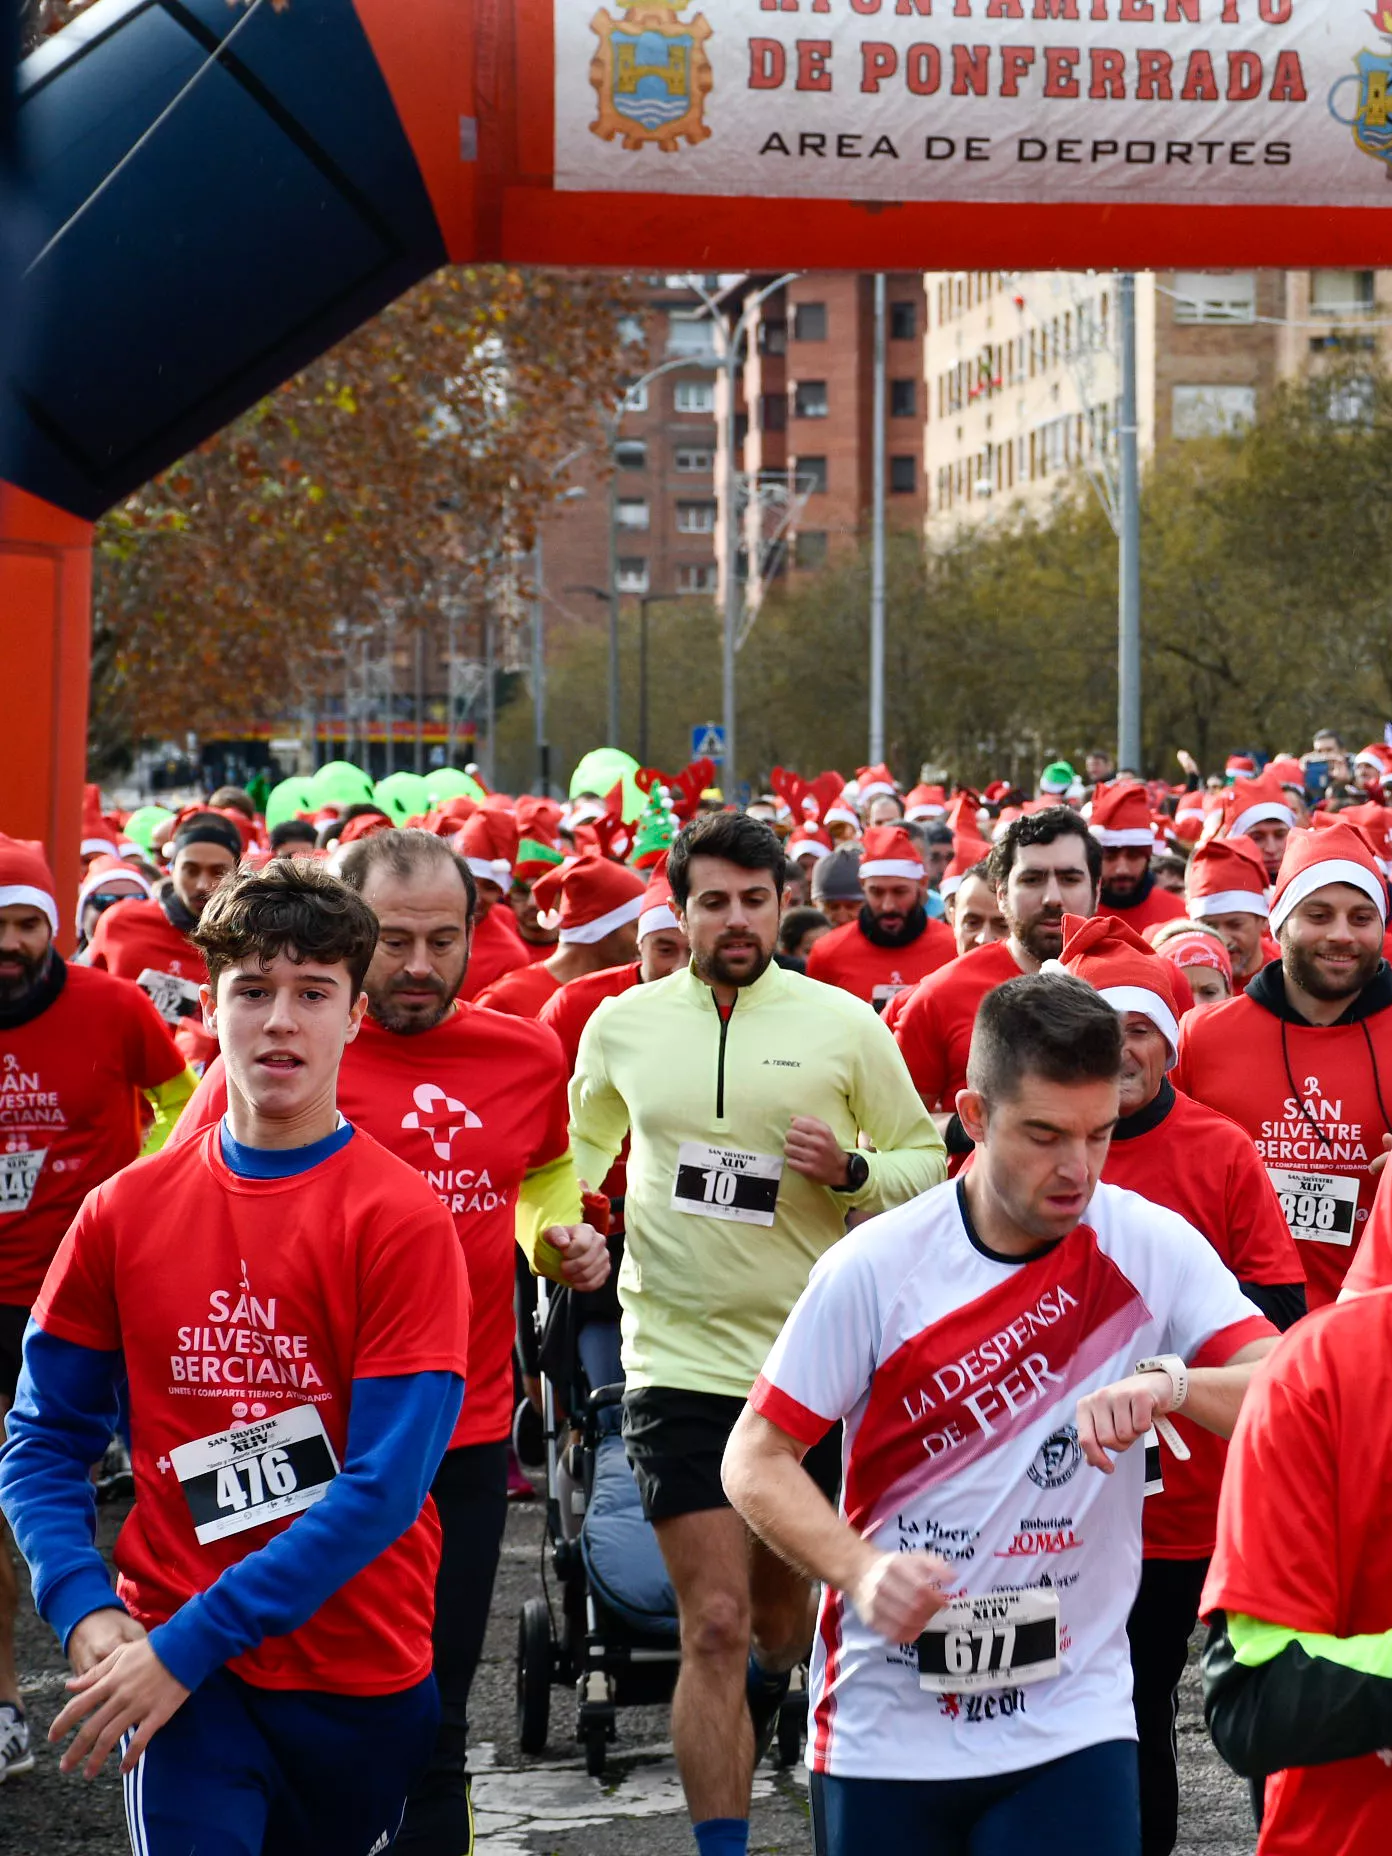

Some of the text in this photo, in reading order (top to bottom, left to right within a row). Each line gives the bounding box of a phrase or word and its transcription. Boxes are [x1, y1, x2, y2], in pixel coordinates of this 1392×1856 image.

[747, 38, 1308, 102] DE PONFERRADA
[758, 131, 1292, 166] AREA DE DEPORTES
[772, 1059, 801, 1068] TERREX
[0, 1072, 40, 1092] AN
[0, 1108, 66, 1124] CIANA
[1283, 1098, 1342, 1121] SAN
[1261, 1121, 1362, 1140] SILVESTRE
[720, 1157, 748, 1169] XLIV
[702, 1170, 737, 1206] 10
[1300, 1182, 1326, 1192] XLIV
[207, 1290, 276, 1330] SAN
[177, 1327, 308, 1359] SILVESTRE
[902, 1284, 1080, 1423] LA DESPENSA
[170, 1355, 323, 1389] BERCIANA
[198, 1389, 245, 1398] COMPARTE
[248, 1390, 283, 1399] TIEMPO
[921, 1420, 967, 1459] DE
[960, 1351, 1066, 1441] FER
[207, 1419, 279, 1448] SAN SILVESTRE
[230, 1432, 268, 1454] XLIV
[215, 1449, 298, 1512] 476
[944, 1624, 1016, 1676] 677
